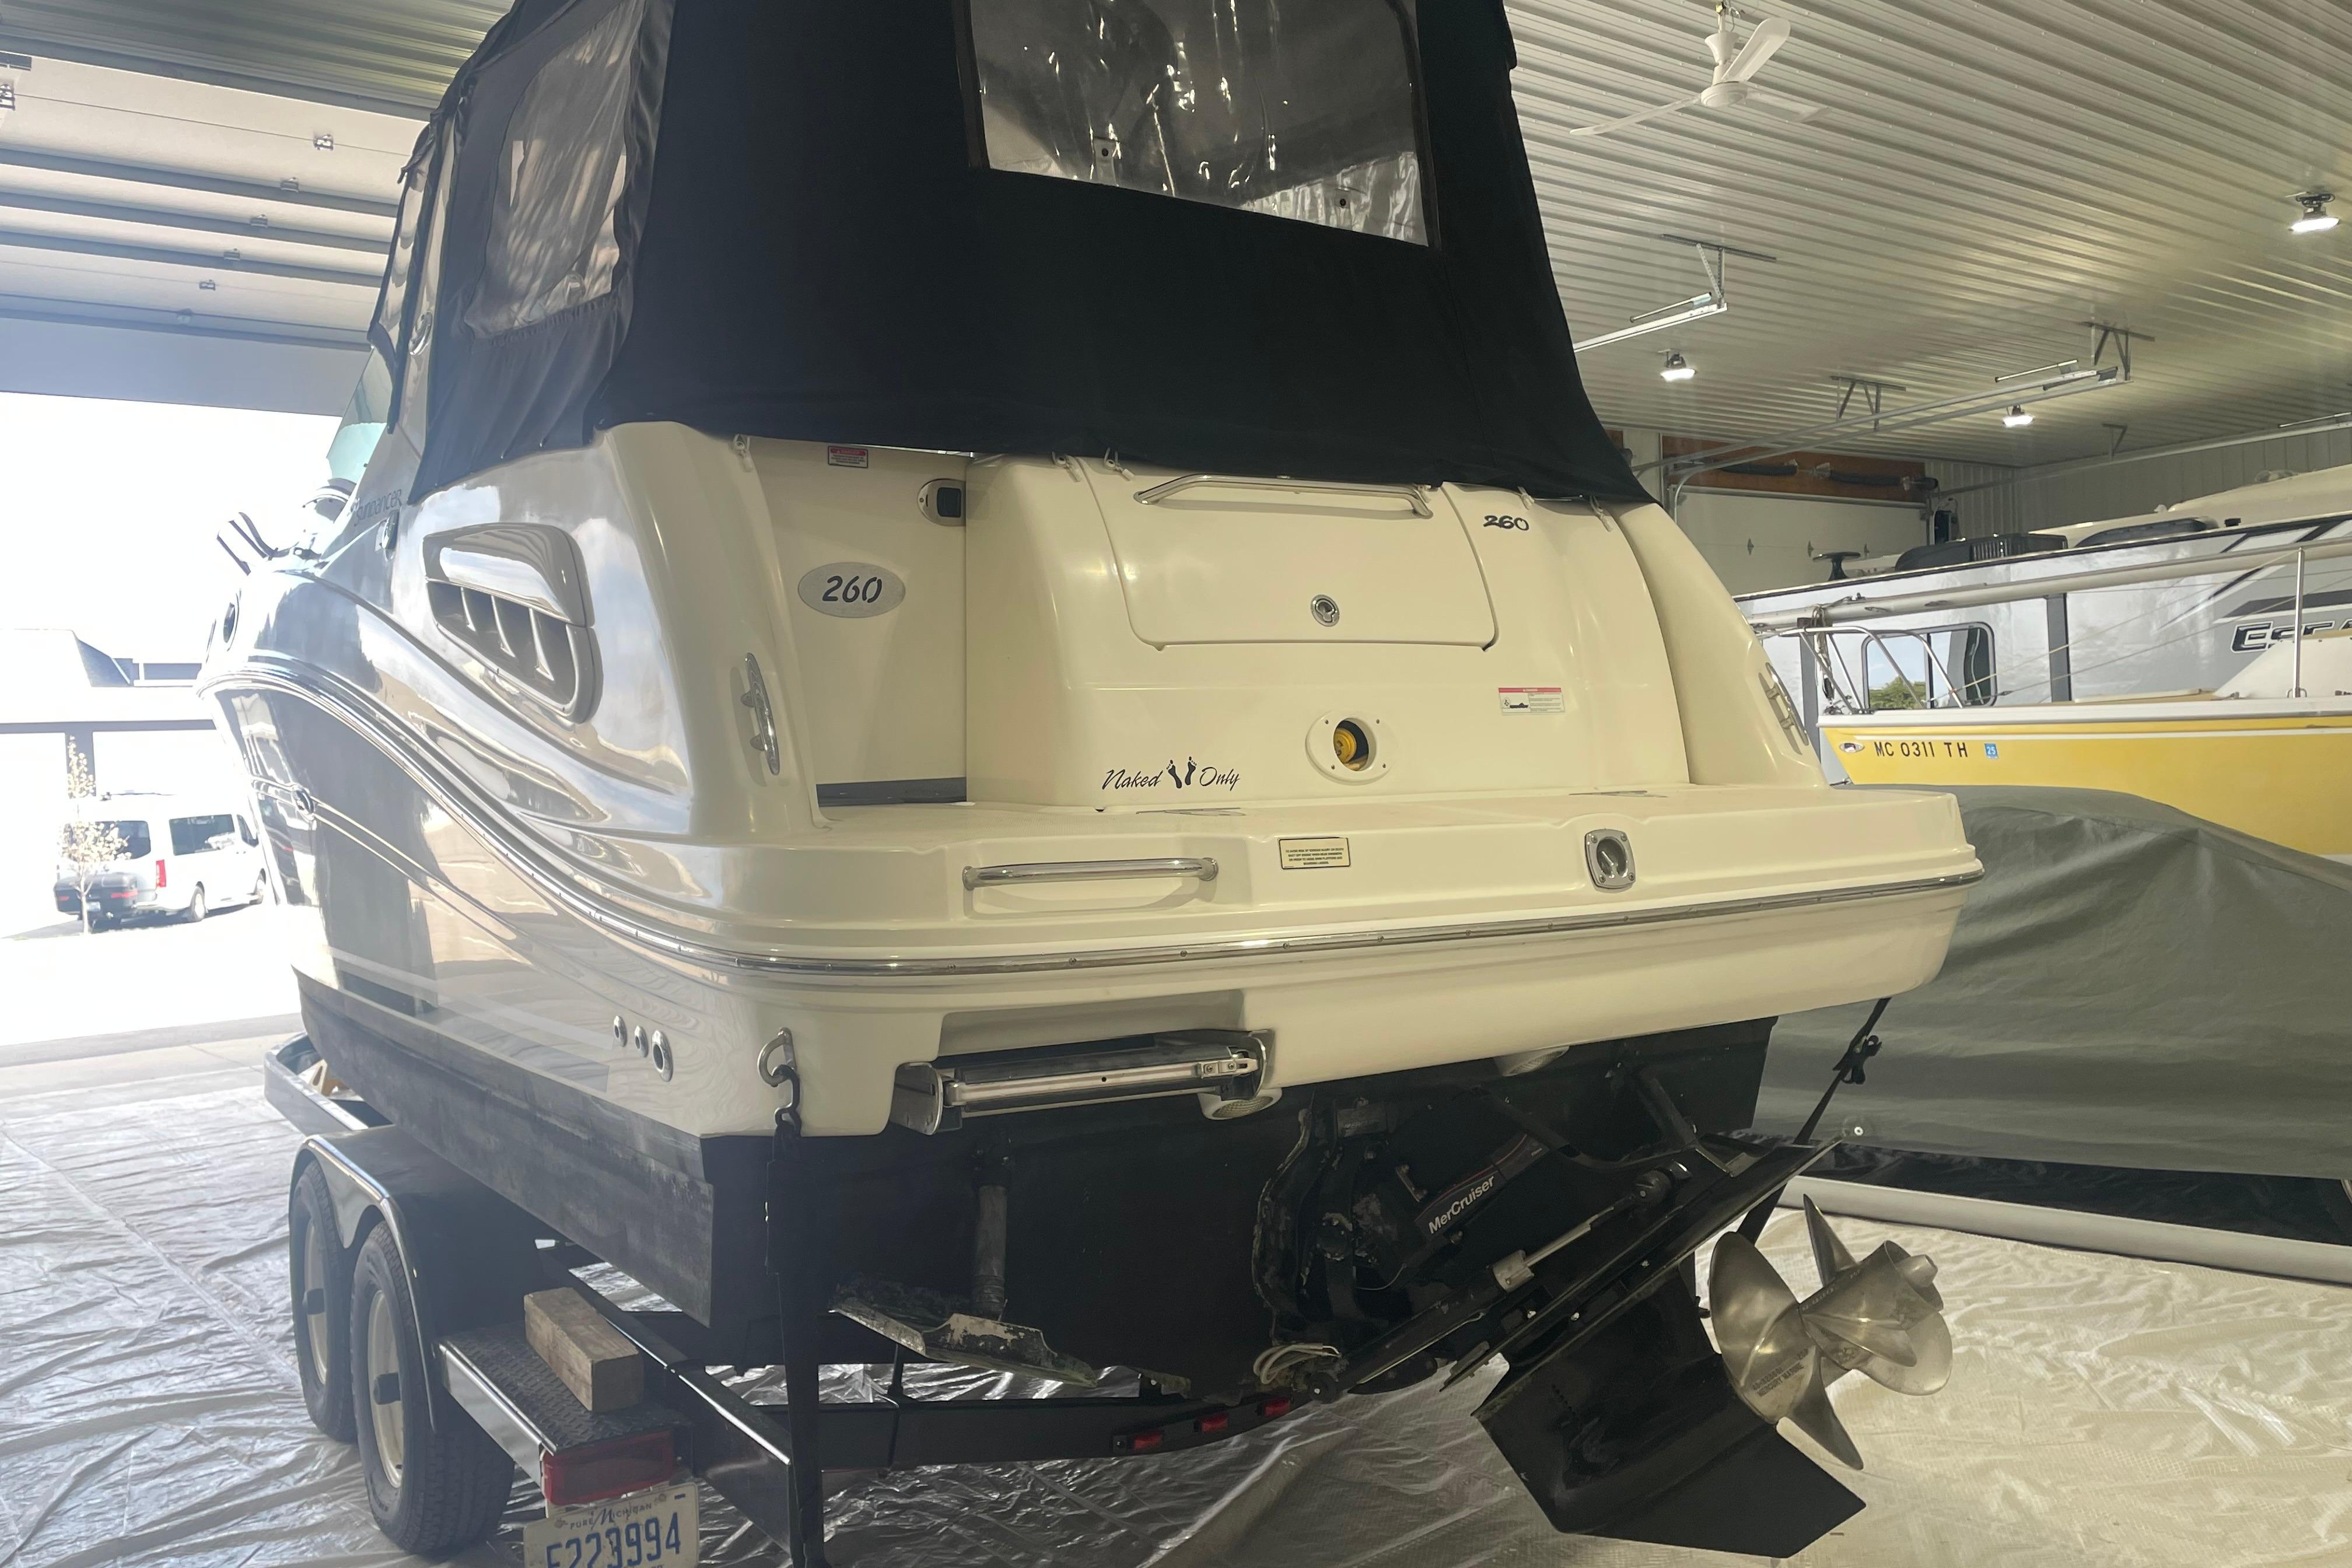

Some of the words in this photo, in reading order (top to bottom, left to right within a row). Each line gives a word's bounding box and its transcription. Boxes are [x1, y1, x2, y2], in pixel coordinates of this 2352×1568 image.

[1483, 515, 1530, 531] 260
[822, 575, 883, 603] 260
[1874, 741, 1894, 757] MC
[1900, 742, 1935, 757] 0311
[1986, 746, 1996, 755] 25
[1101, 769, 1164, 790] Naked
[1199, 766, 1241, 791] Only
[1429, 1176, 1494, 1234] MerCruiser
